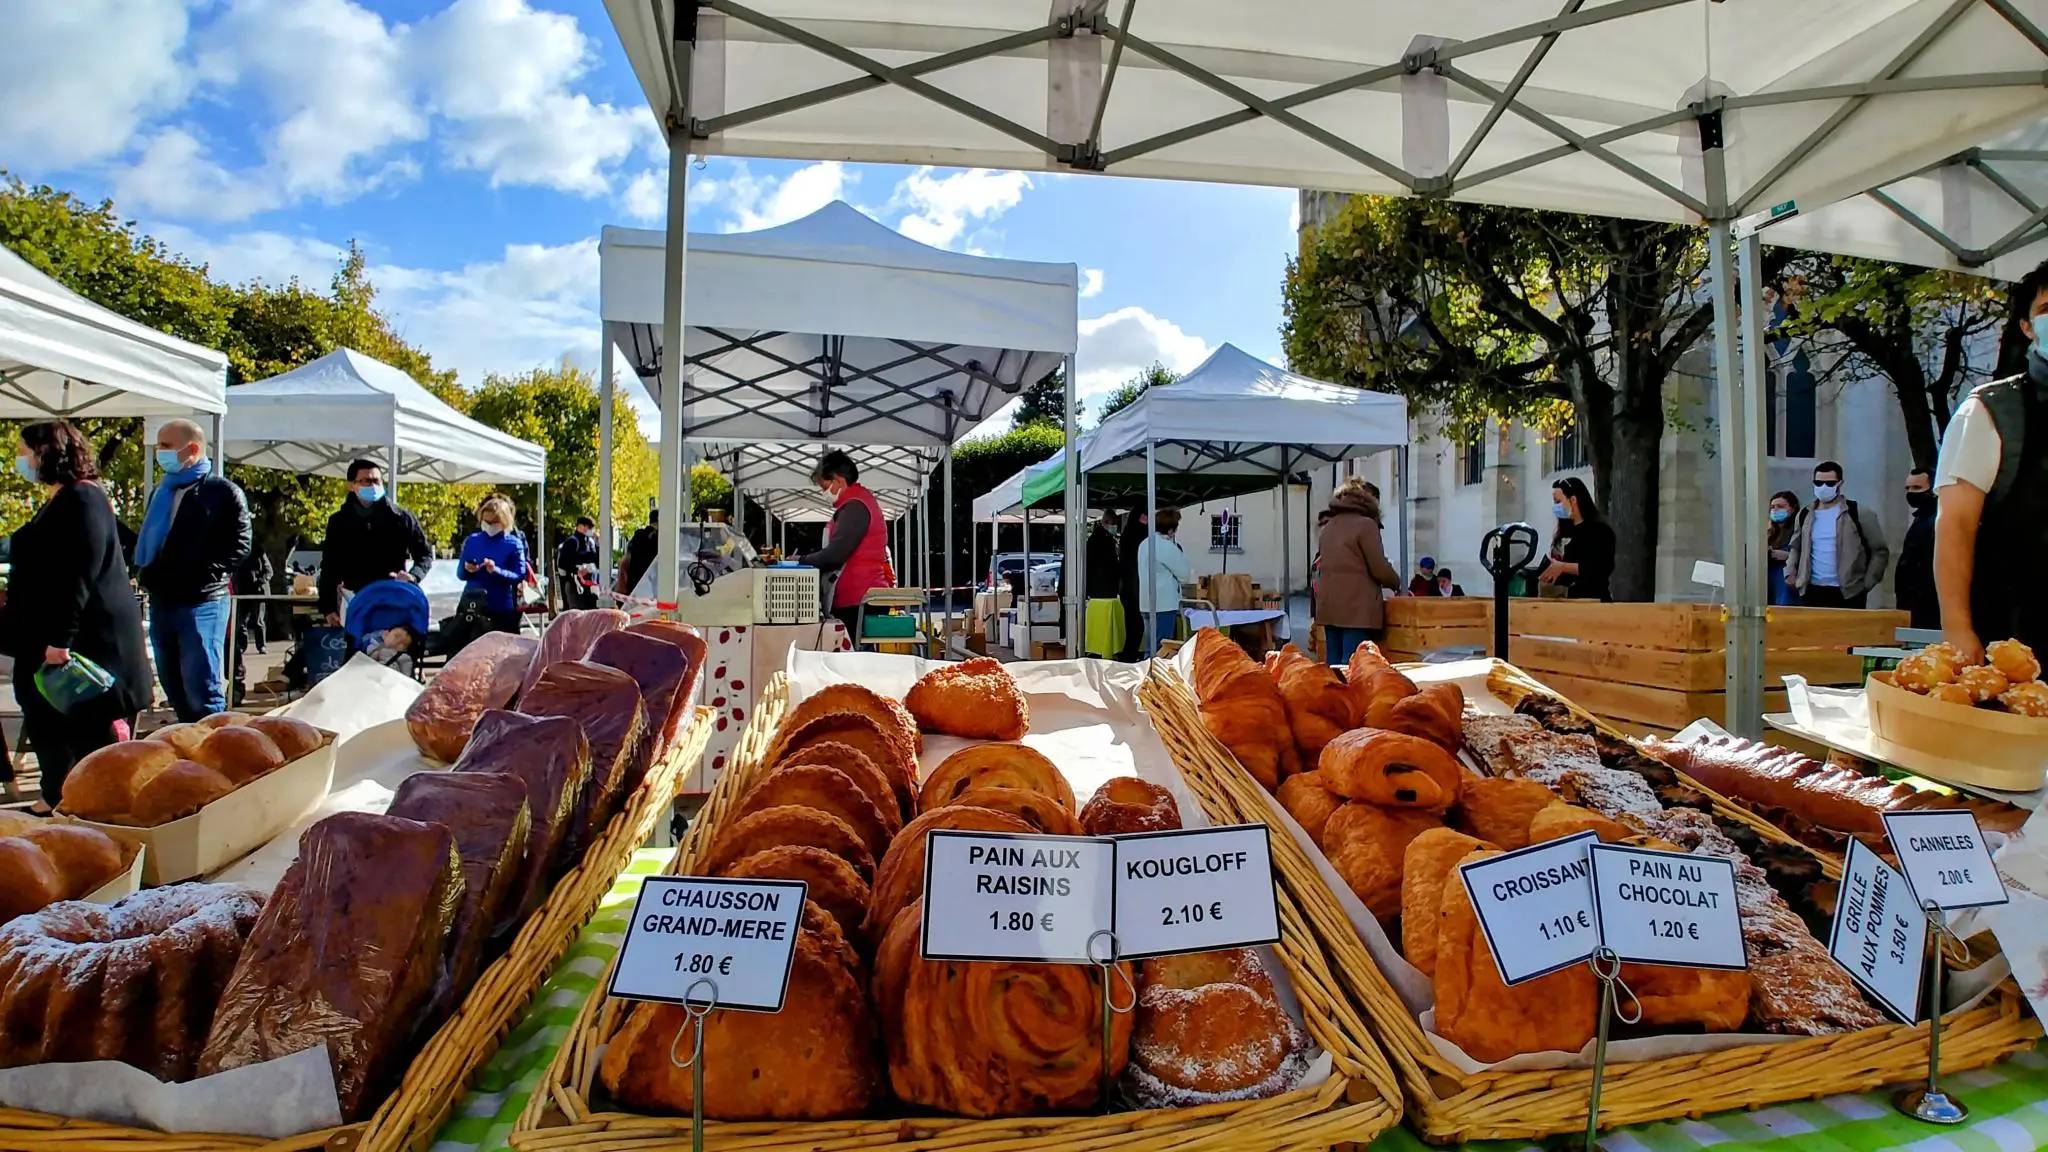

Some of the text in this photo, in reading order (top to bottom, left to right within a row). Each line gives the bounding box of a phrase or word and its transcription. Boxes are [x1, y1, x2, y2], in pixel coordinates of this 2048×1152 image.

[1909, 834, 1974, 853] CANNELES
[969, 846, 1080, 869] PAIN AUX
[1126, 851, 1247, 880] KOUGLOFF
[1629, 859, 1702, 883] PAIN AU
[1938, 868, 1973, 886] 2.00 €
[976, 874, 1071, 897] RAISINS
[1618, 883, 1719, 909] CHOCOLAT
[662, 888, 780, 911] CHAUSSON
[1845, 871, 1868, 934] GRILLE
[989, 910, 1054, 932] 1.80 €
[1161, 901, 1223, 926] 2.10 €
[1539, 910, 1590, 941] 1.10 €
[1860, 865, 1890, 979] AUX POMMES
[643, 914, 787, 941] GRAND-MERE
[1649, 919, 1699, 940] 1.20 €
[1890, 914, 1909, 965] 3.50 €
[674, 952, 733, 976] 1.80 €
